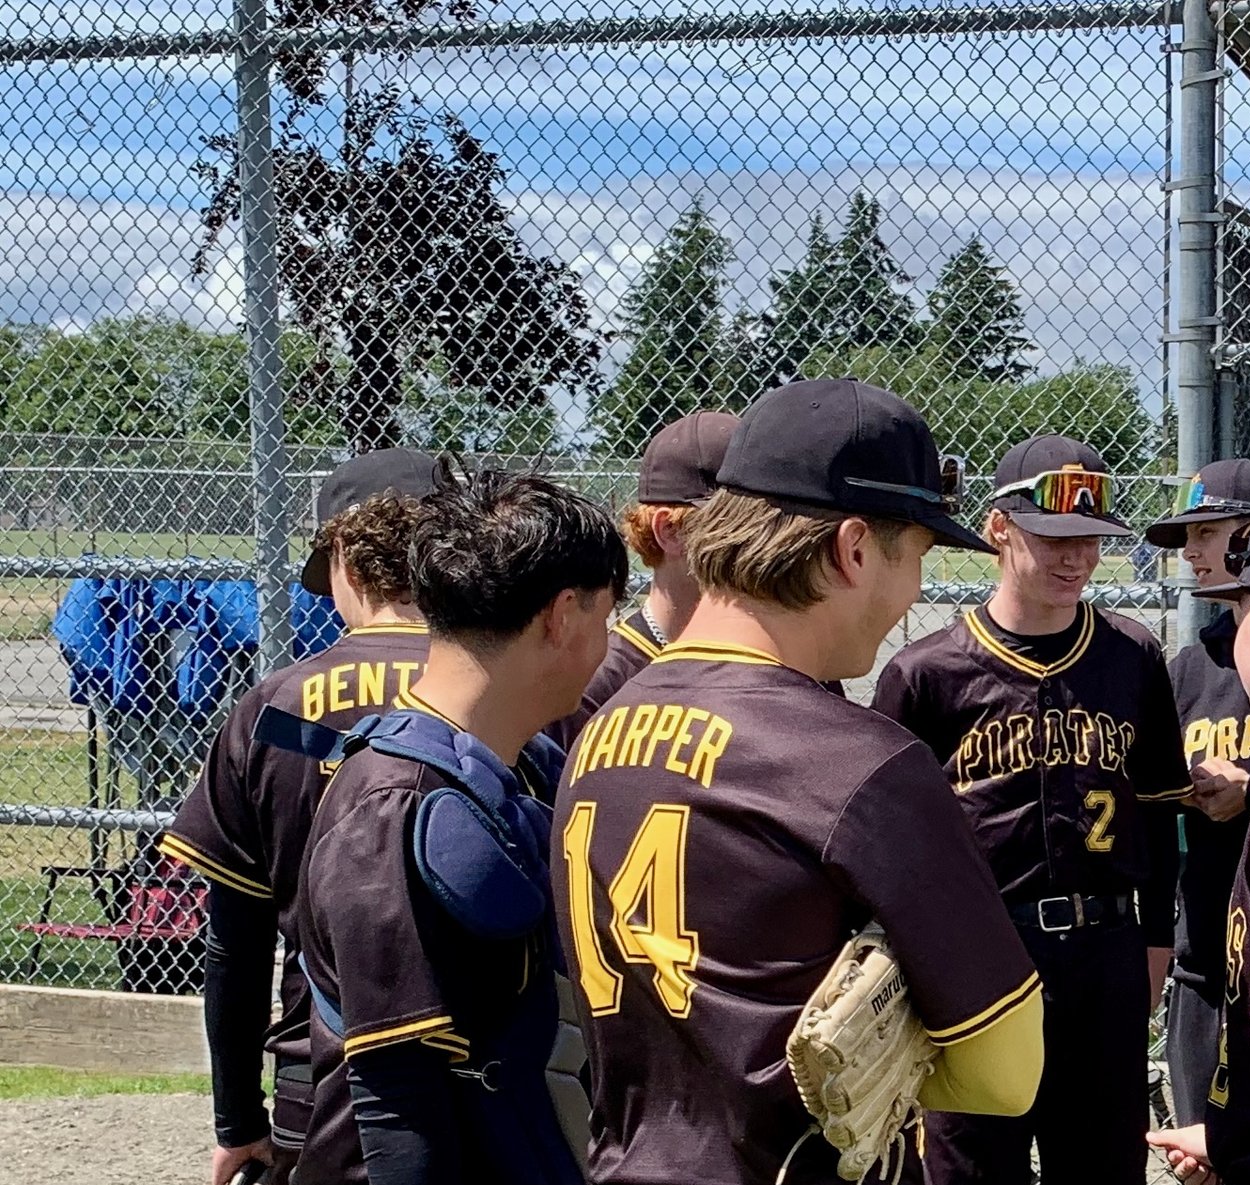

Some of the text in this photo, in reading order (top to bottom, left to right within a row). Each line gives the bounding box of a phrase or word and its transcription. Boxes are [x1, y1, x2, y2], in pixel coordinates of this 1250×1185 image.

[303, 662, 428, 722] BENT
[569, 705, 733, 788] HARPER
[1084, 790, 1116, 852] 2
[564, 801, 699, 1019] 14
